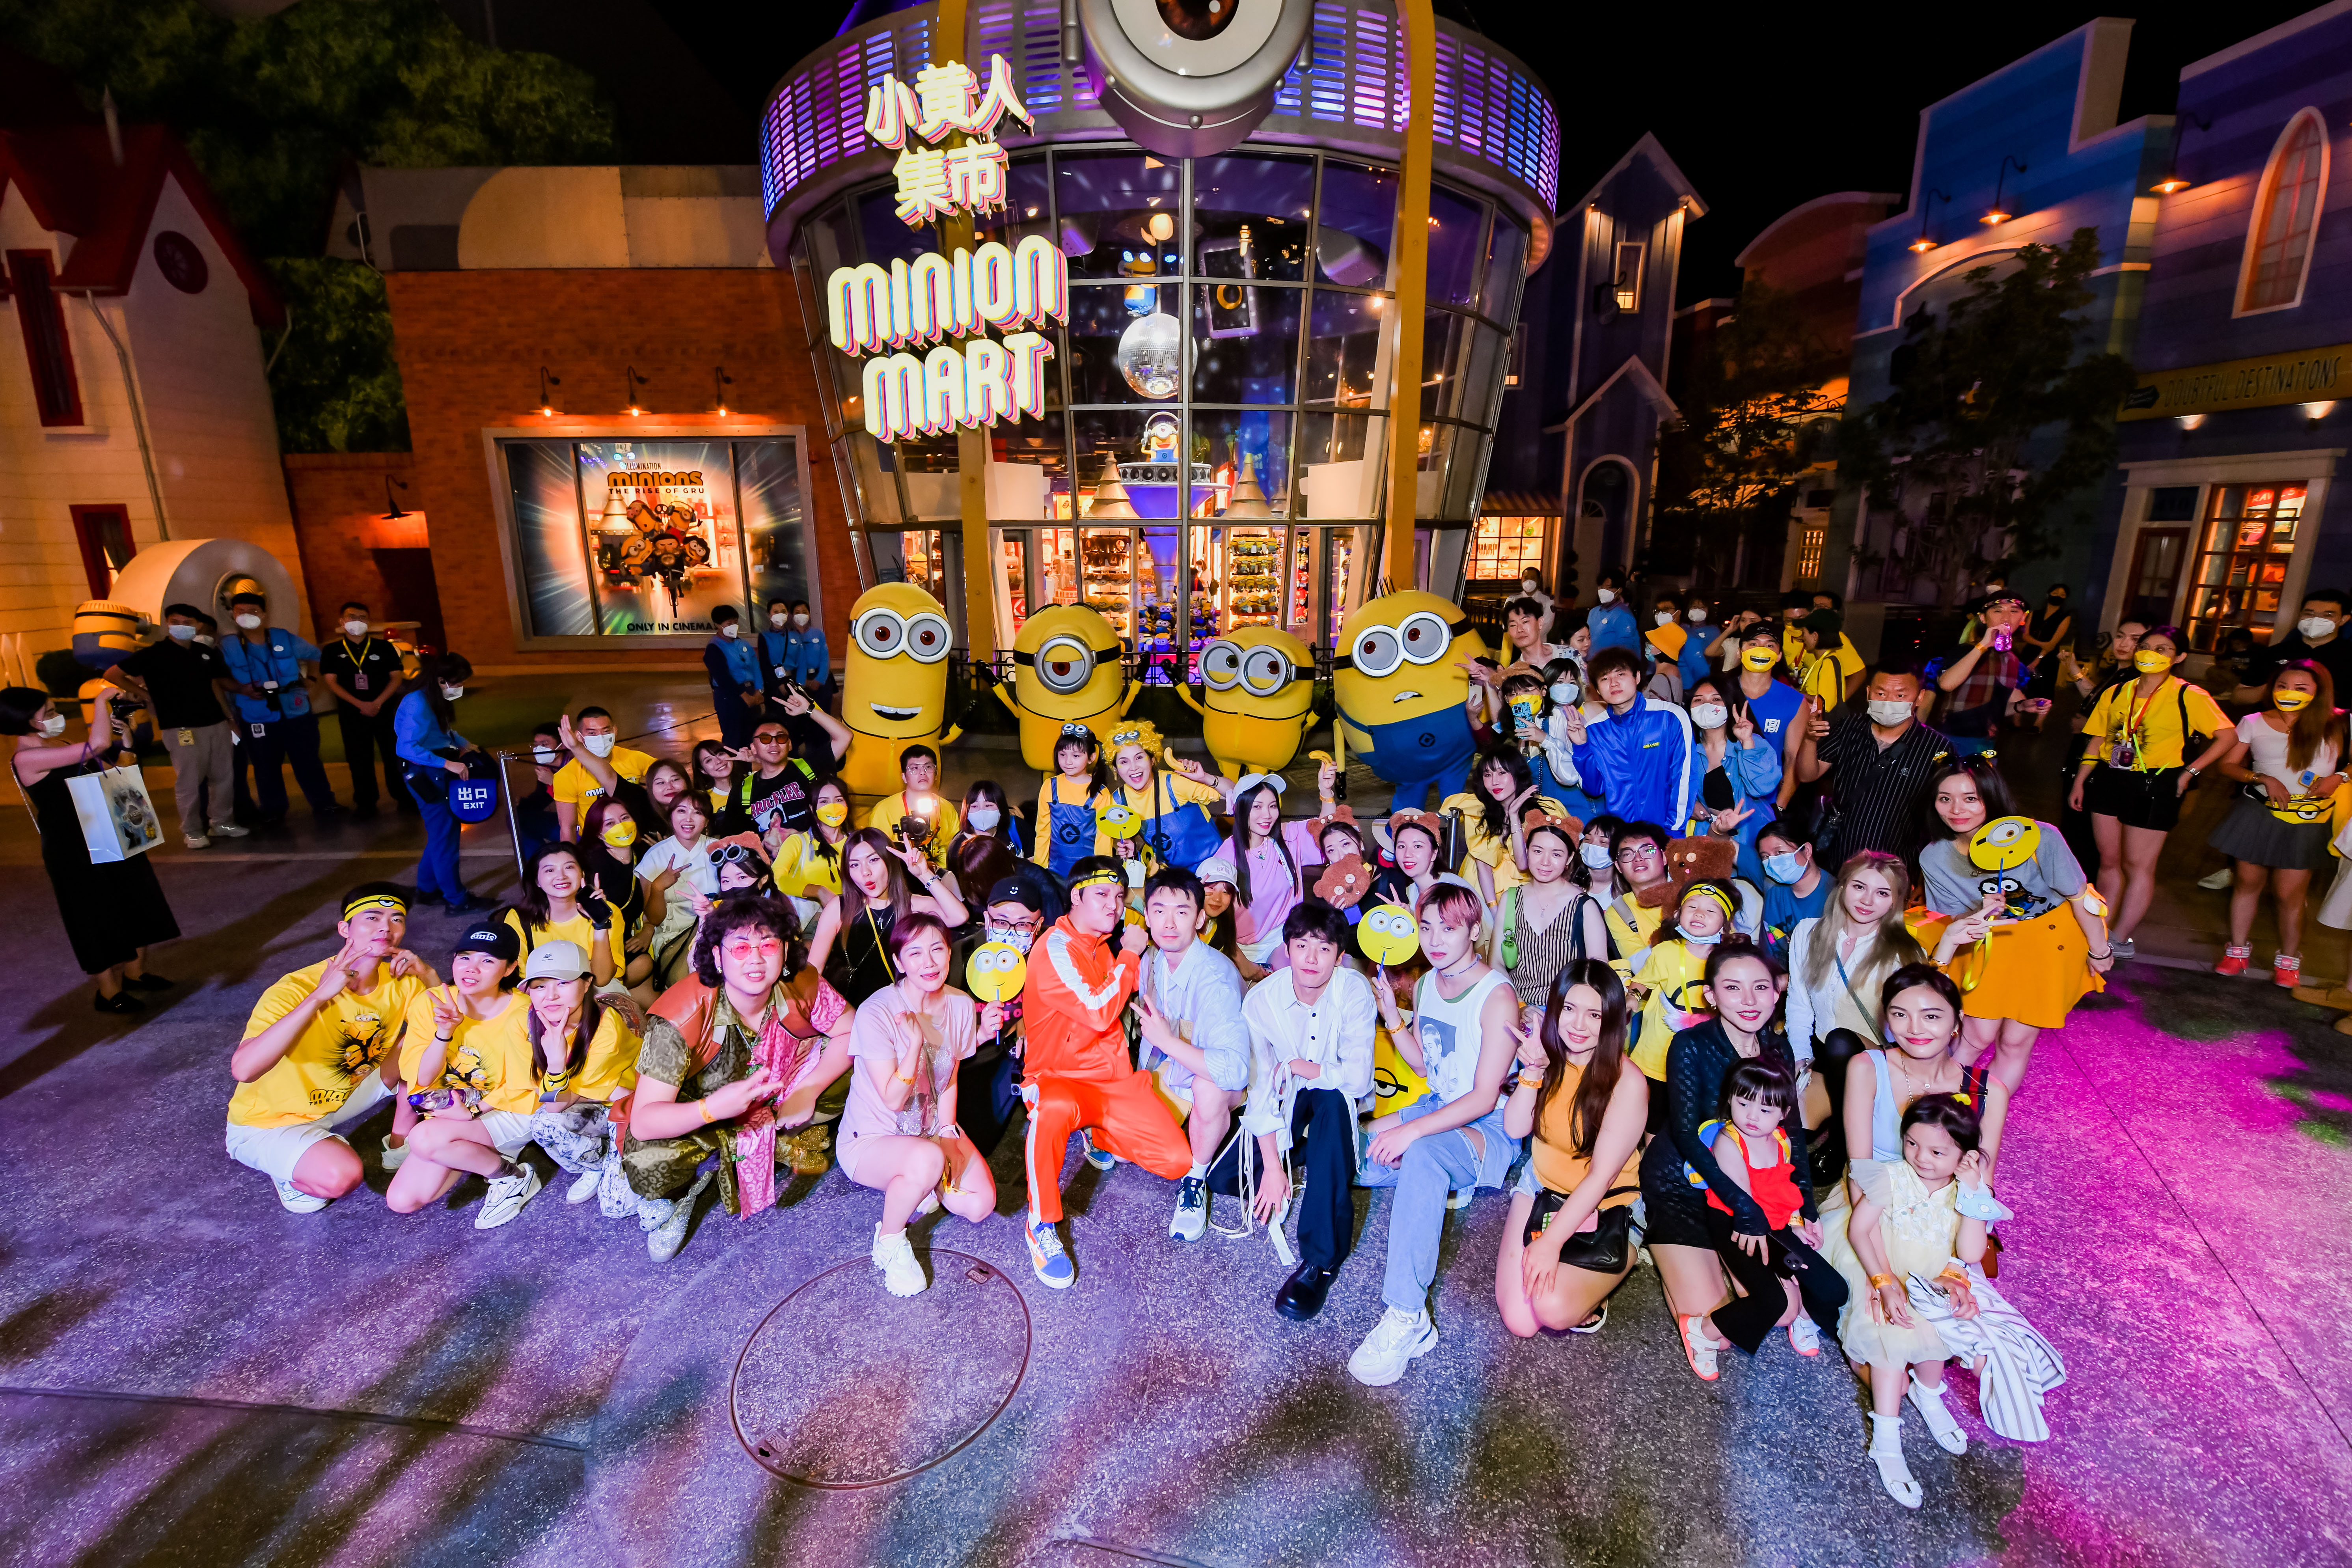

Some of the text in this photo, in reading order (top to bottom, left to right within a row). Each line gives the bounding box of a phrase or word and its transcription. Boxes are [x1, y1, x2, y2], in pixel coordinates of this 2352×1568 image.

[865, 53, 1034, 150] 小黄人
[894, 138, 1009, 229] 集市
[827, 235, 1070, 358] MINION
[863, 332, 1055, 444] MART
[2164, 371, 2229, 407] DOUBTFUL
[2235, 356, 2341, 399] DESTINATIONS
[458, 787, 487, 800] 出口
